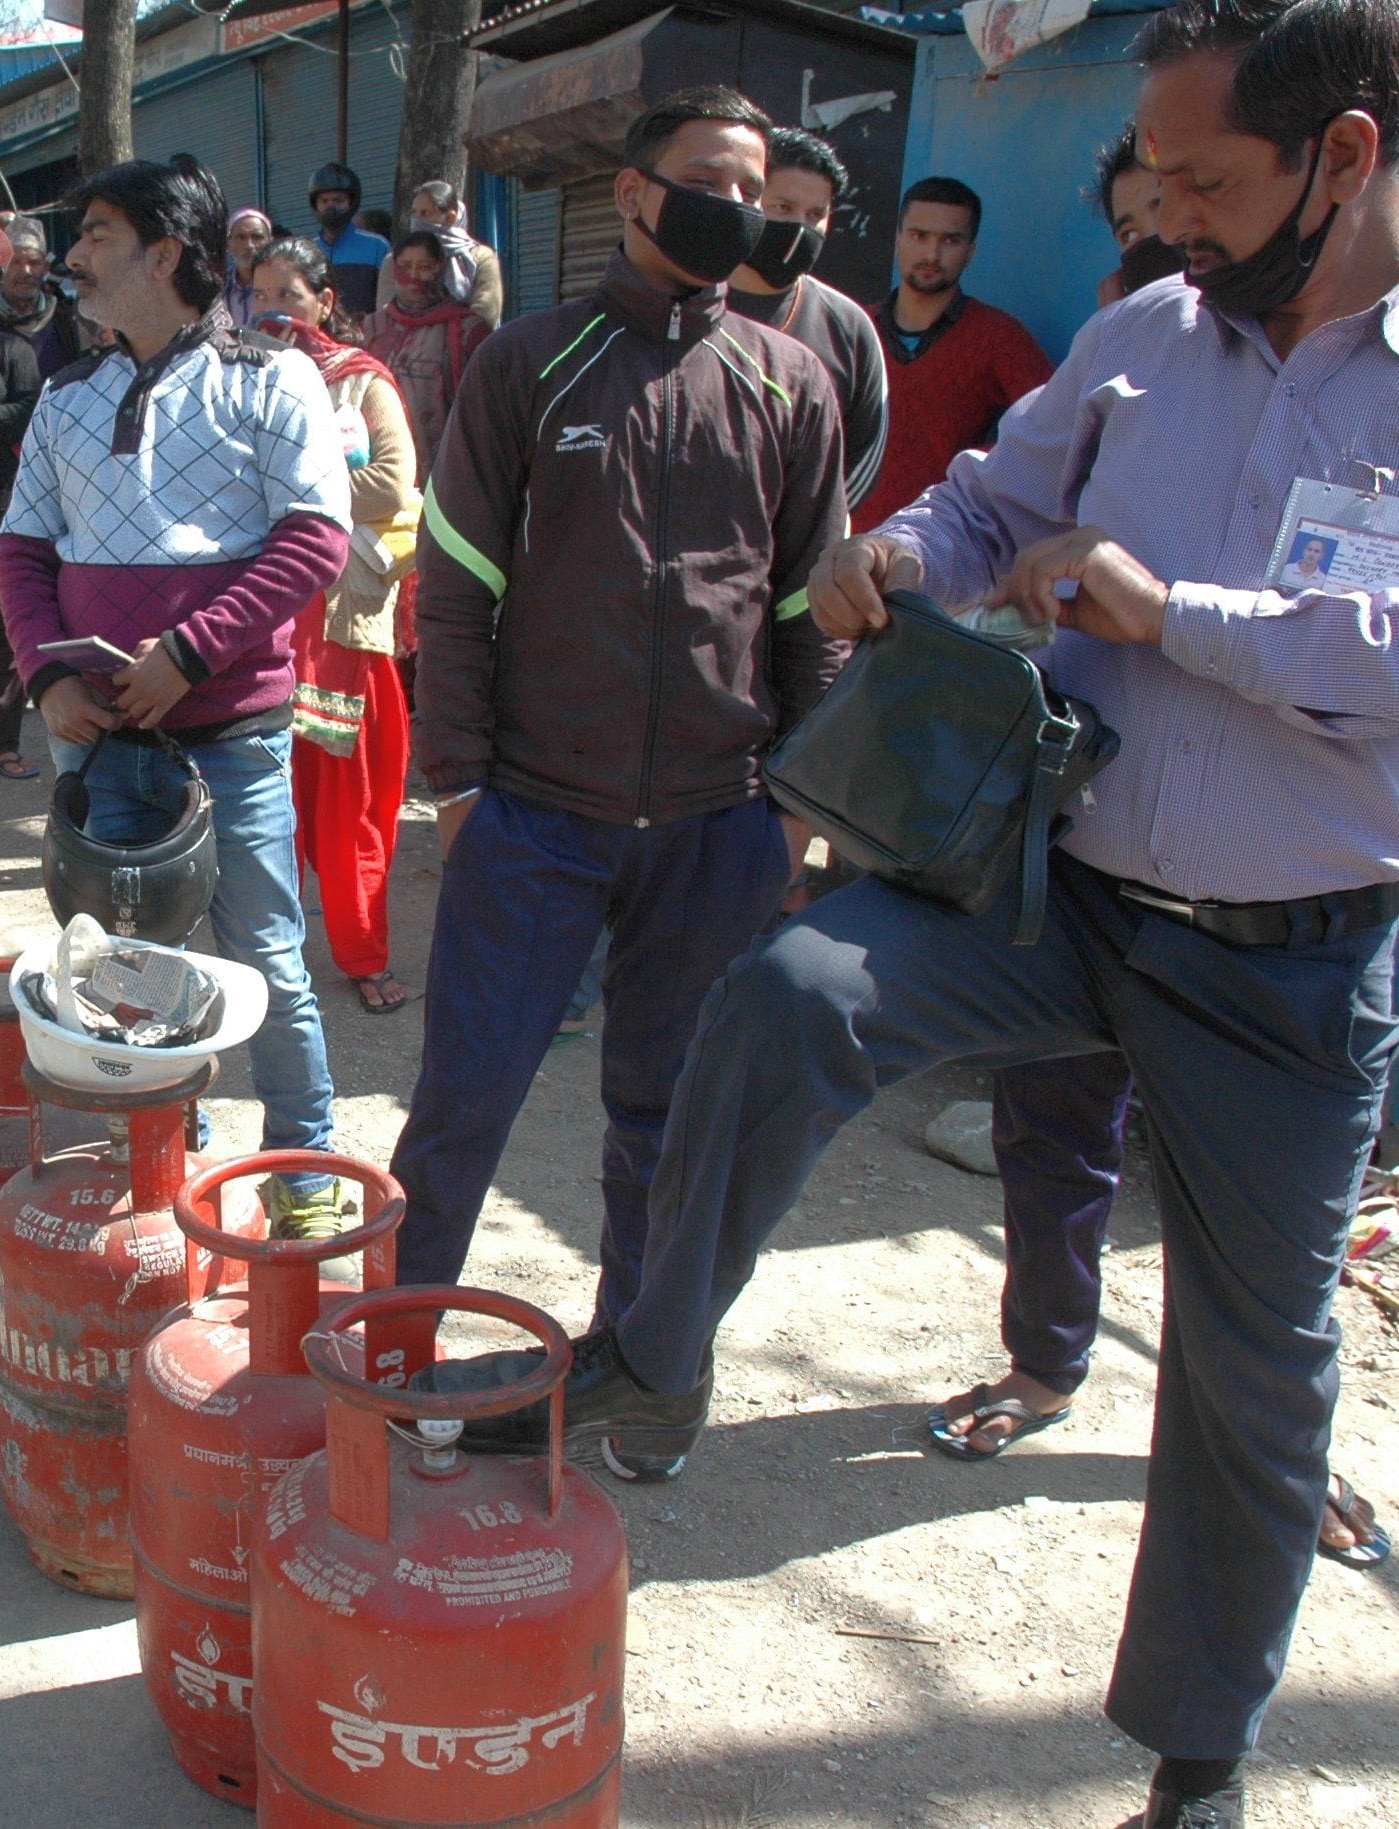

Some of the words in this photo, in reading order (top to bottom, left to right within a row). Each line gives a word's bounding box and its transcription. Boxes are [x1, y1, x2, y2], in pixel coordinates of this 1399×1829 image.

[68, 1188, 116, 1206] 15.6
[459, 1500, 524, 1532] 16.8
[316, 1691, 597, 1775] इण्डन
